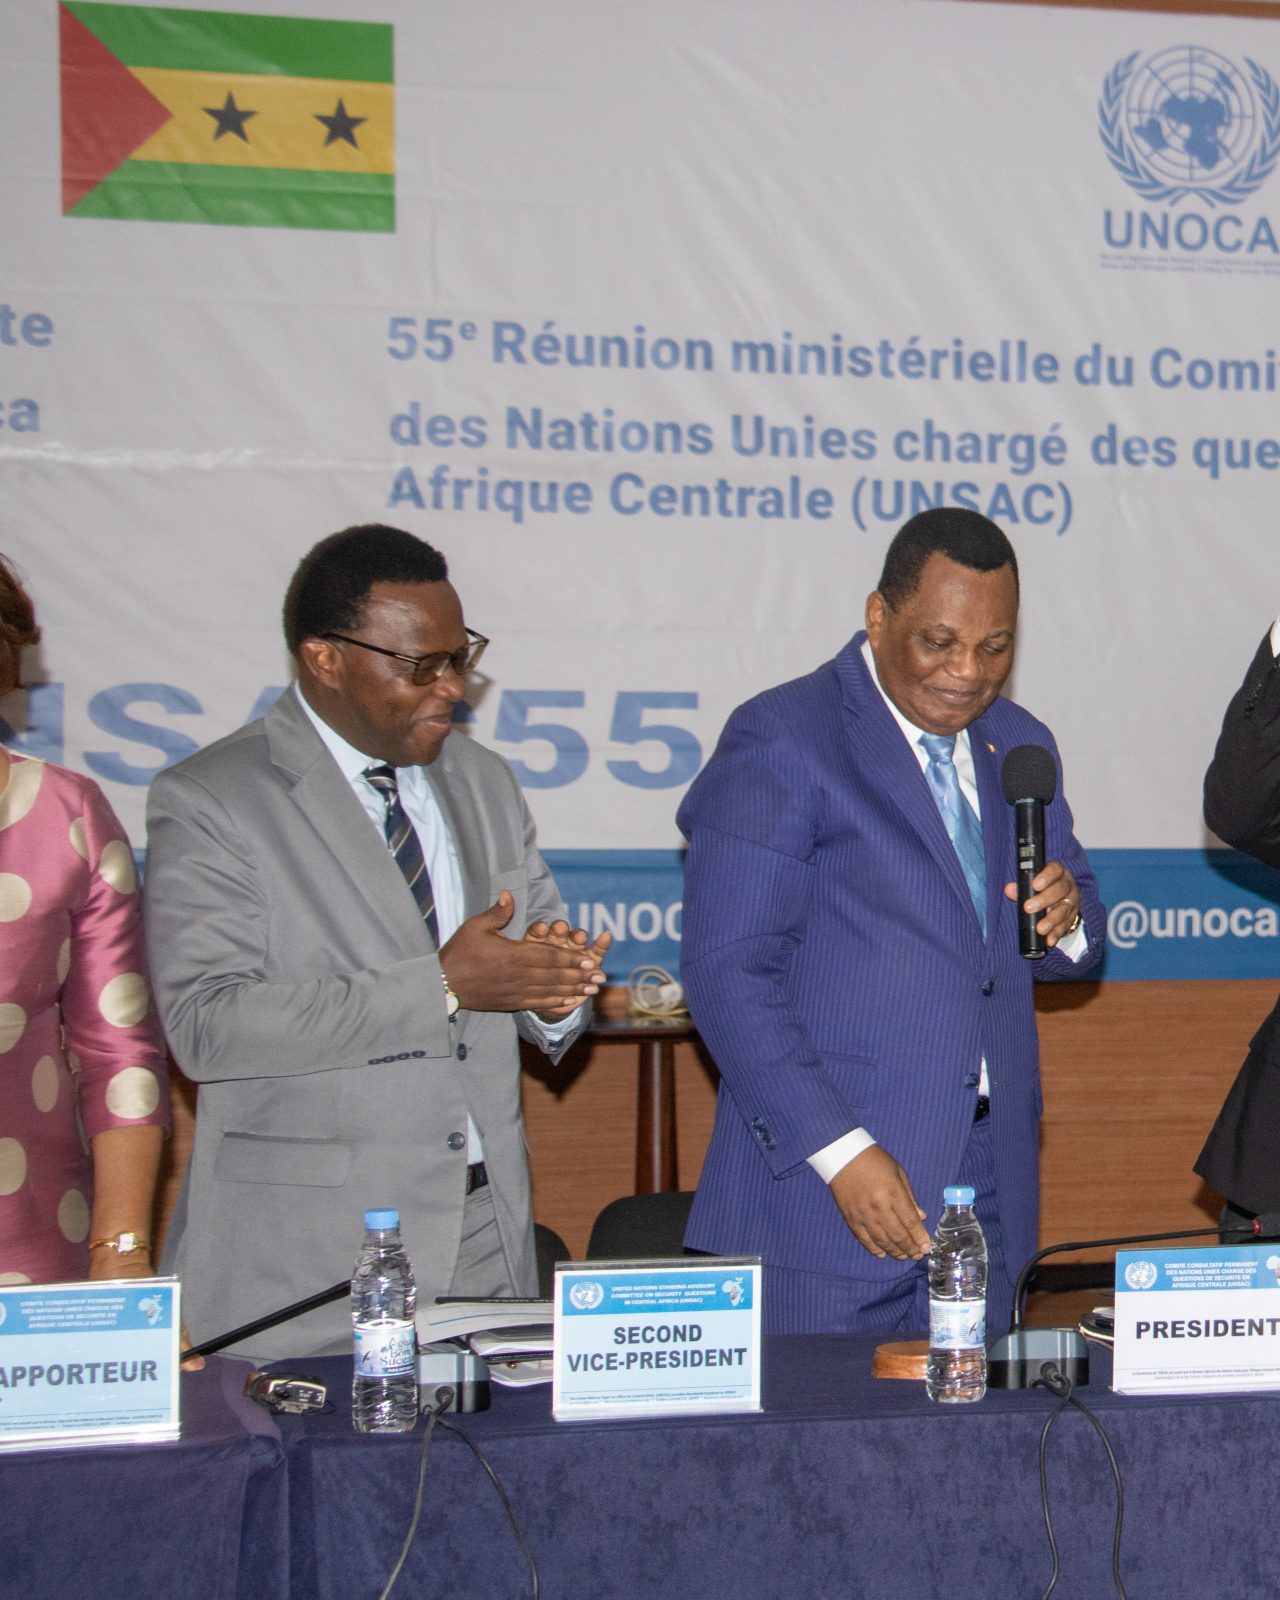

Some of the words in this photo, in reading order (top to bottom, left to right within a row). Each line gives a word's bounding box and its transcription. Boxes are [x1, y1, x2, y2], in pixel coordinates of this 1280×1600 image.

[1103, 209, 1280, 255] UNOCA
[492, 320, 714, 372] Réunion
[731, 331, 1060, 385] ministérielle
[1074, 343, 1133, 387] du
[390, 400, 488, 449] des
[505, 406, 714, 456] Nations
[731, 414, 877, 461] Unies
[893, 418, 1067, 476] chargé
[1091, 423, 1177, 468] des
[386, 464, 593, 524] Afrique
[609, 471, 834, 519] Centrale
[852, 475, 1072, 537] (UNSAC)
[567, 1348, 747, 1372] VICE-PRESIDENT
[613, 1324, 702, 1345] SECOND
